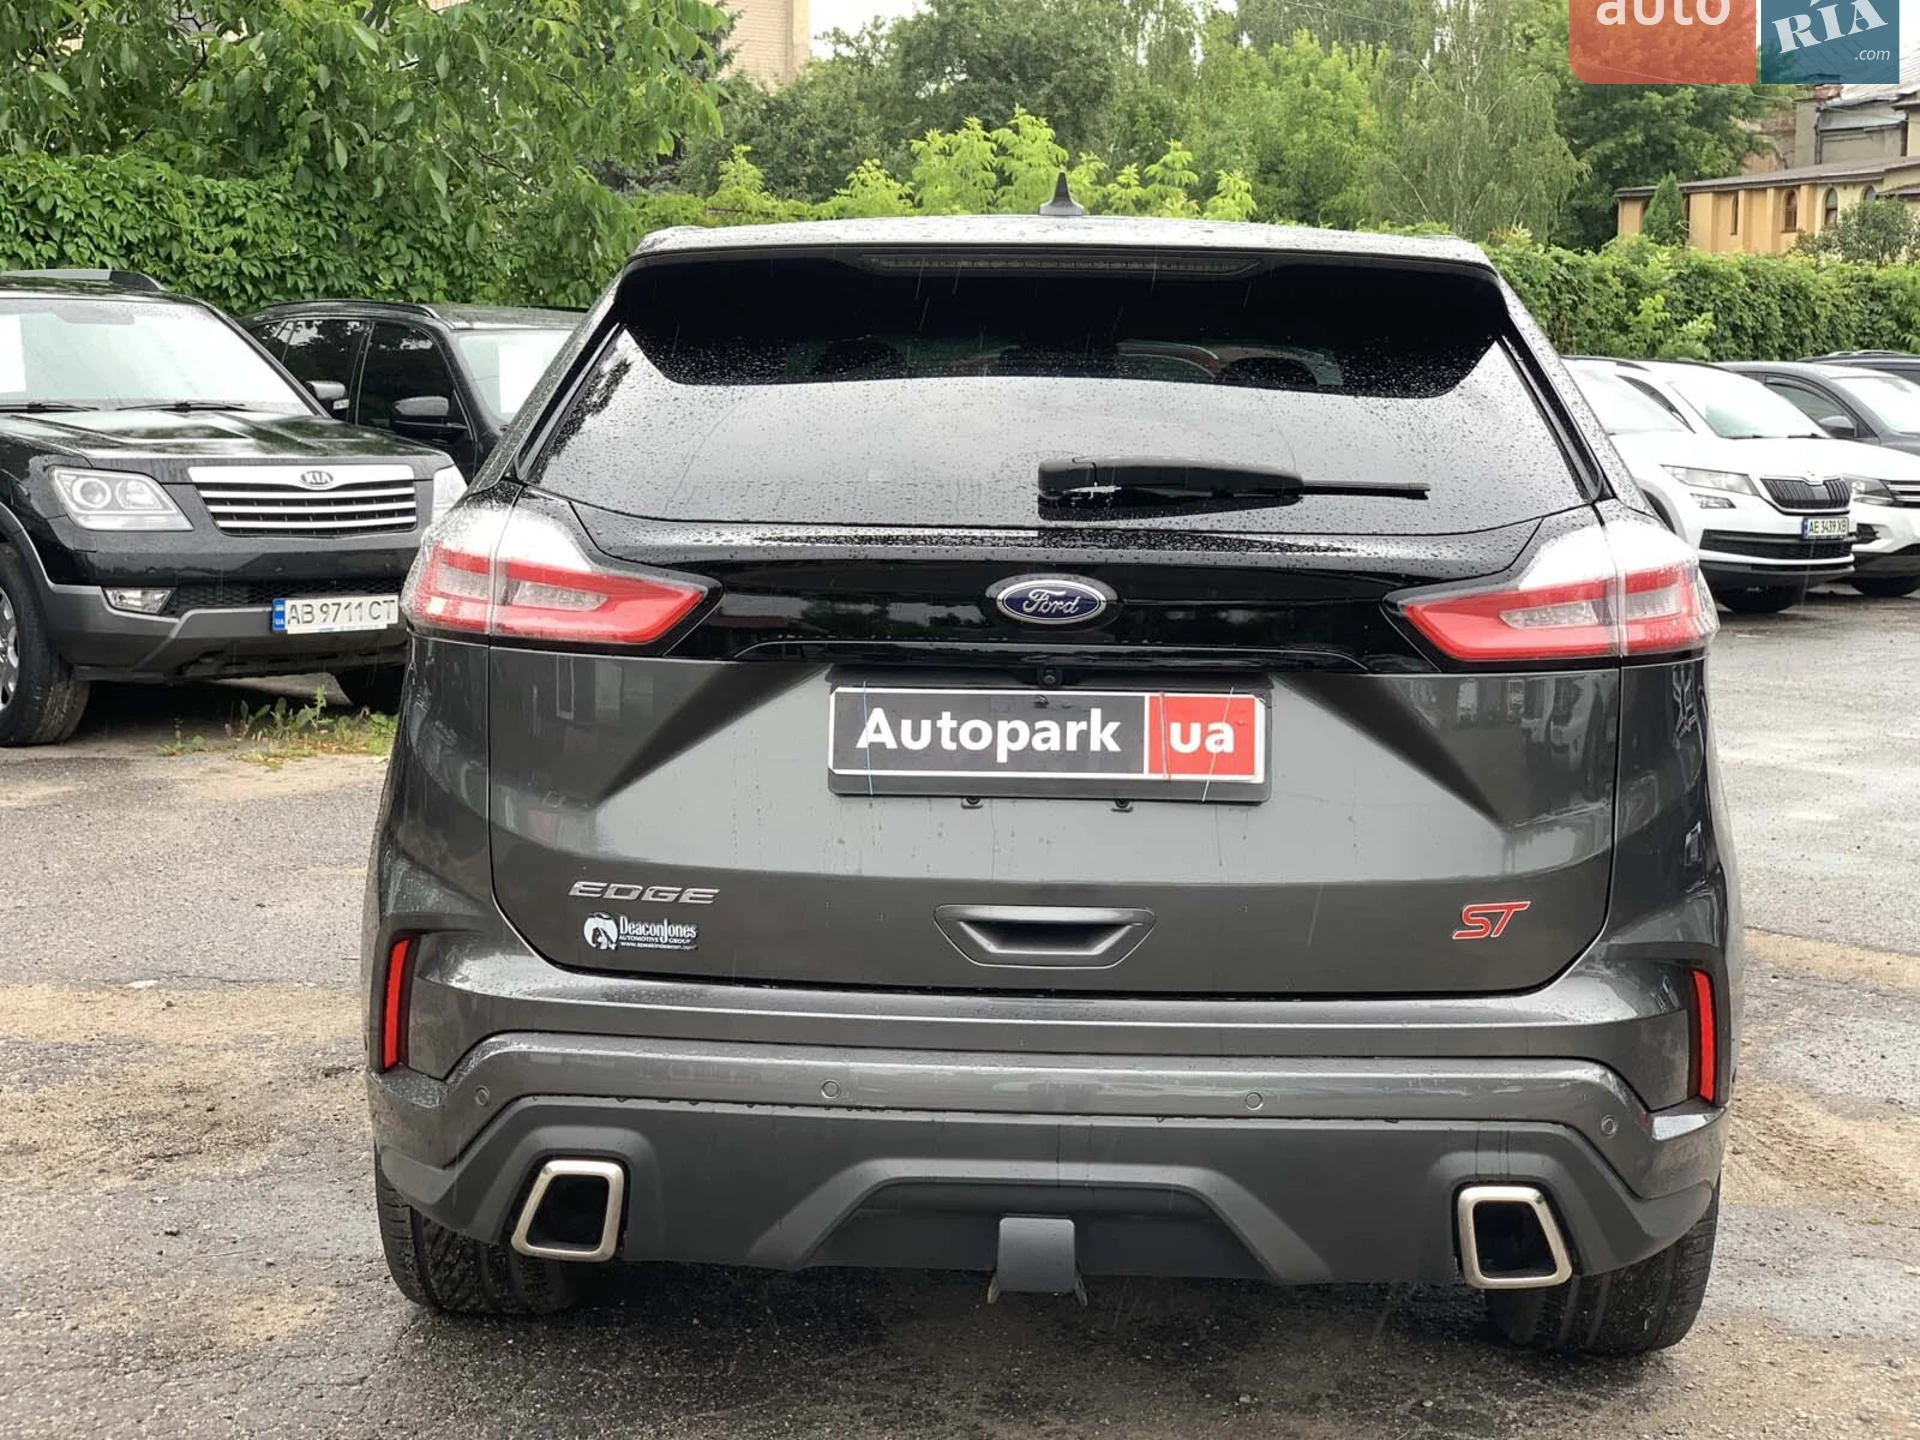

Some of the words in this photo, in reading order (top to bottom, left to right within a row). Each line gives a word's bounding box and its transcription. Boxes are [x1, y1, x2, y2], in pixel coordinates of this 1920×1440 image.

[304, 471, 331, 485] KIA
[287, 604, 316, 625] AB
[320, 602, 364, 623] 9711
[369, 600, 396, 620] CT
[1022, 588, 1081, 614] Ford
[855, 707, 1121, 763] Autopark
[1169, 720, 1235, 754] ua
[568, 881, 721, 905] EDGE
[1452, 900, 1532, 940] ST
[618, 935, 659, 944] AUTOMOTIVE
